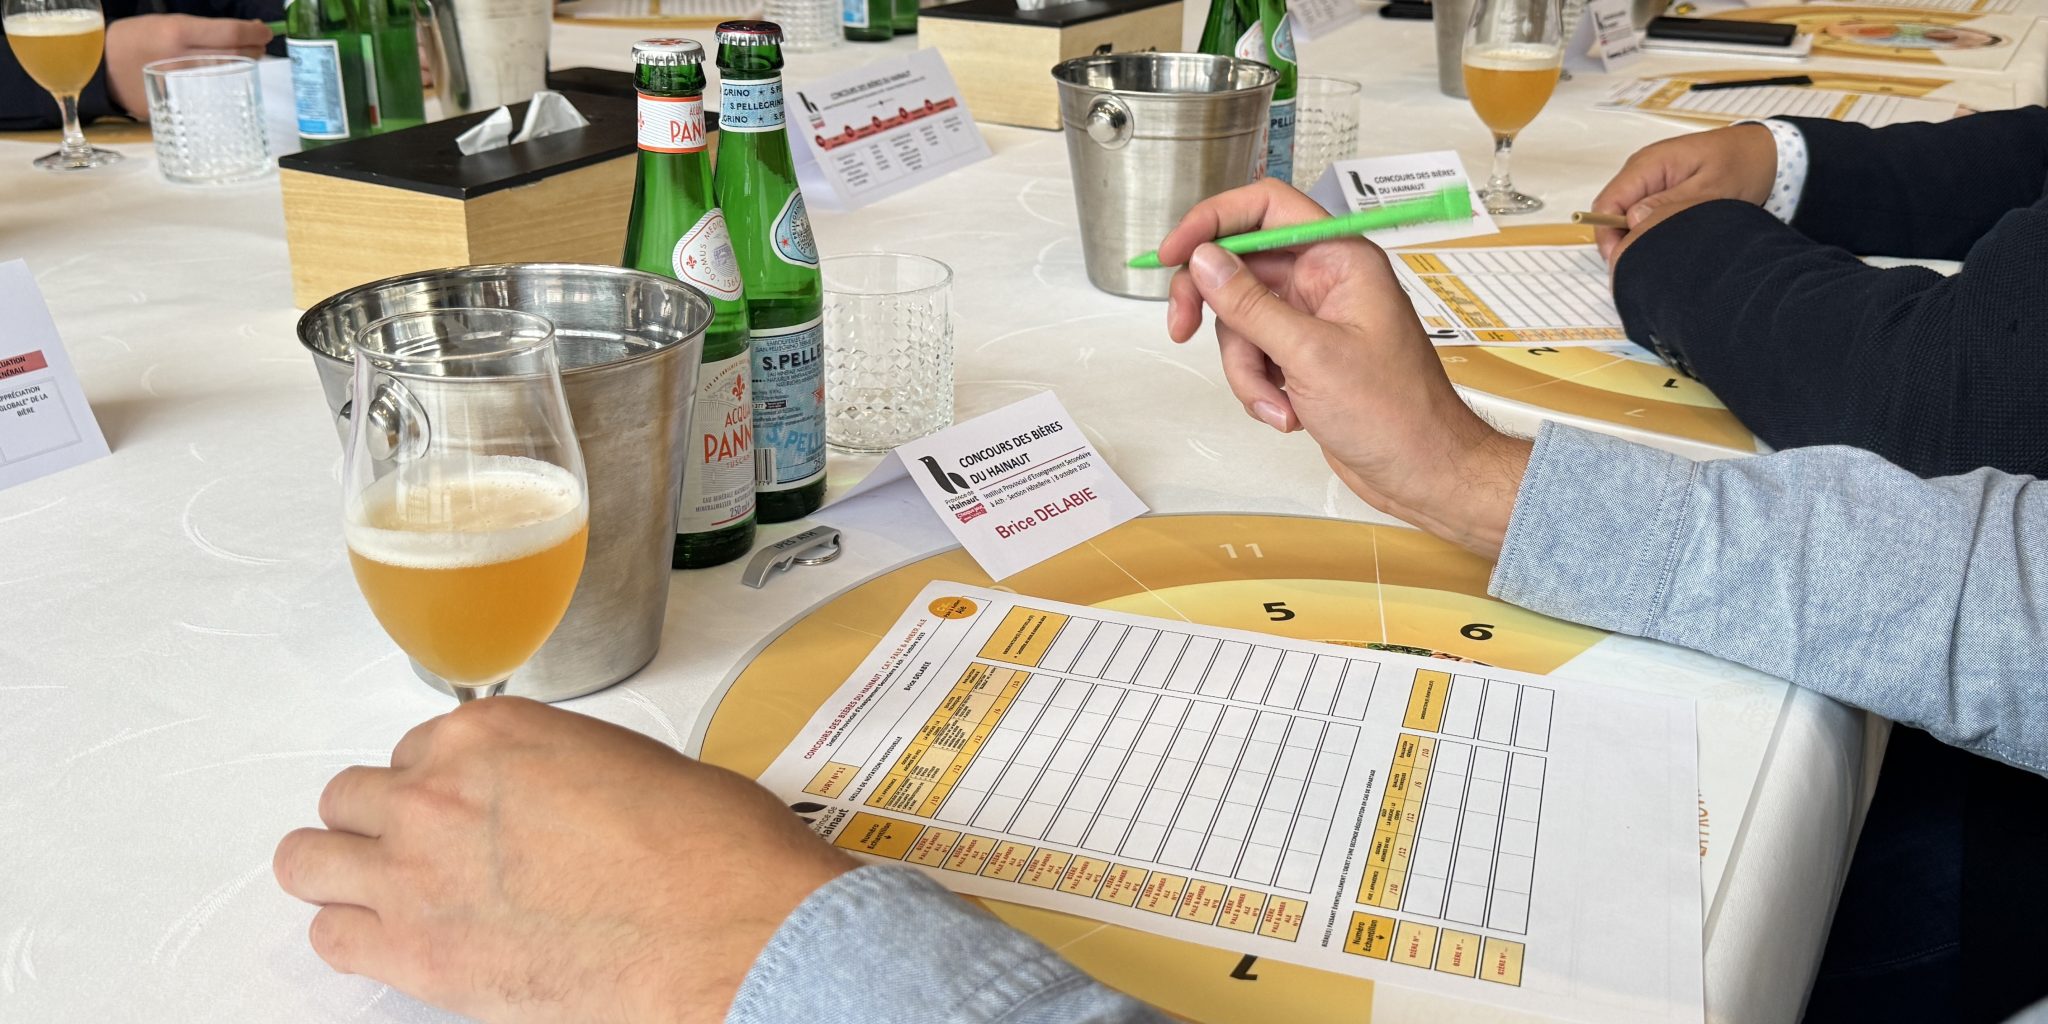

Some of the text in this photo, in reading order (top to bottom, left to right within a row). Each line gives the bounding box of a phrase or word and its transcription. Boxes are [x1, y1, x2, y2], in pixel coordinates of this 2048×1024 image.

[1374, 168, 1456, 184] CONCOURS DES BIÈRES
[1378, 183, 1425, 195] DU HAINAUT
[700, 244, 716, 281] DOMUS
[30, 394, 39, 404] DE
[40, 393, 48, 401] LA
[17, 406, 35, 417] BIÈRE
[959, 421, 1063, 468] CONCOURS DES BIÈRES
[970, 453, 1030, 484] DU HAINAUT
[983, 452, 1091, 499] Institut Provincial d'Enseignement Secondaire
[1007, 489, 1027, 500] Section
[1026, 479, 1051, 492] Hôtellerie
[1059, 468, 1078, 478] octobre
[1077, 462, 1091, 471] 2025
[948, 496, 979, 511] Hainaut
[995, 487, 1097, 539] Brice DELABIE
[1219, 542, 1264, 559] 11
[1263, 601, 1296, 621] 5
[1459, 623, 1495, 640] 6
[904, 661, 931, 691] Brice DELABIE
[804, 730, 833, 759] CONCOURS
[829, 719, 842, 729] DES
[838, 701, 857, 718] BIÈRES
[860, 673, 882, 693] HAINAUT
[890, 648, 904, 659] PALE
[904, 628, 918, 643] AMBER
[917, 619, 927, 627] ALE
[974, 735, 983, 744] /12
[864, 762, 882, 782] NOTATION
[953, 765, 962, 774] /12
[819, 767, 846, 793] JURY N°11
[828, 806, 837, 814] de
[930, 796, 940, 806] /10
[1406, 813, 1415, 822] /12
[860, 824, 879, 843] Numéro
[867, 823, 892, 849] Echantillon
[919, 832, 941, 860] PALE AMBER
[956, 840, 977, 867] PALE AMBER
[1398, 847, 1407, 858] /12
[994, 847, 1014, 874] PALE AMBER
[1032, 854, 1052, 881] PALE AMBER
[1046, 865, 1054, 873] ALE
[1070, 861, 1089, 889] PALE AMBER
[1110, 870, 1127, 898] PALE AMBER
[1149, 878, 1166, 907] PALE AMBER
[1163, 890, 1171, 898] ALE
[1389, 884, 1398, 895] /10
[1189, 886, 1206, 916] PALE AMBER
[1203, 898, 1211, 906] ALE
[1230, 894, 1246, 924] PALE AMBER
[1243, 906, 1251, 915] ALE
[1272, 902, 1286, 933] PALE AMBER
[1284, 915, 1292, 923] ALE
[1352, 922, 1365, 945] Numéro
[1362, 920, 1377, 952] Echantillon
[1409, 943, 1418, 958] BIÈRE
[1453, 951, 1462, 967] BIÈRE
[1497, 960, 1506, 975] BIÈRE
